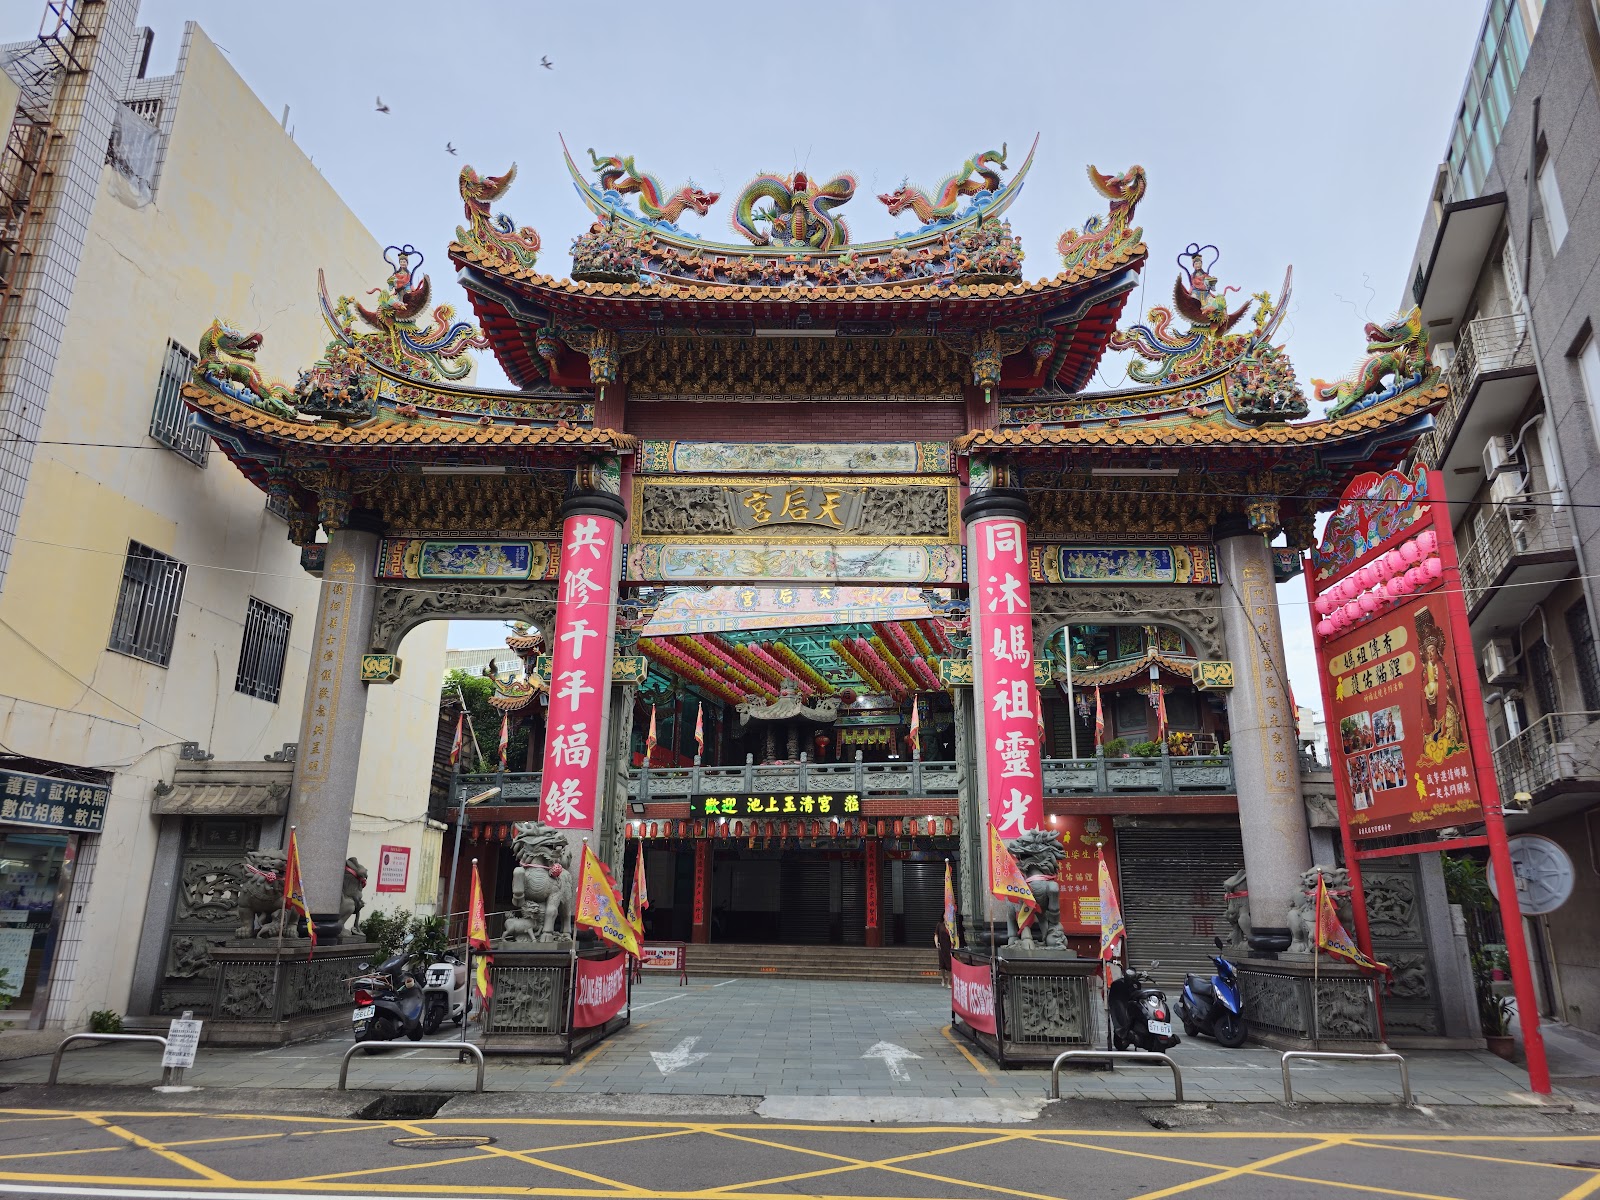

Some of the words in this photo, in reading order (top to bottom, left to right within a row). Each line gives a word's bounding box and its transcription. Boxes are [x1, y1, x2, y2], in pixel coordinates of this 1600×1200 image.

[743, 486, 845, 526] 天后宮
[1344, 632, 1393, 670] 媽祖傳香
[545, 517, 606, 826] 共修千年福緣
[986, 522, 1040, 837] 同沐媽祖靈光
[705, 797, 738, 815] 歡迎
[747, 795, 833, 813] 池上玉清宮
